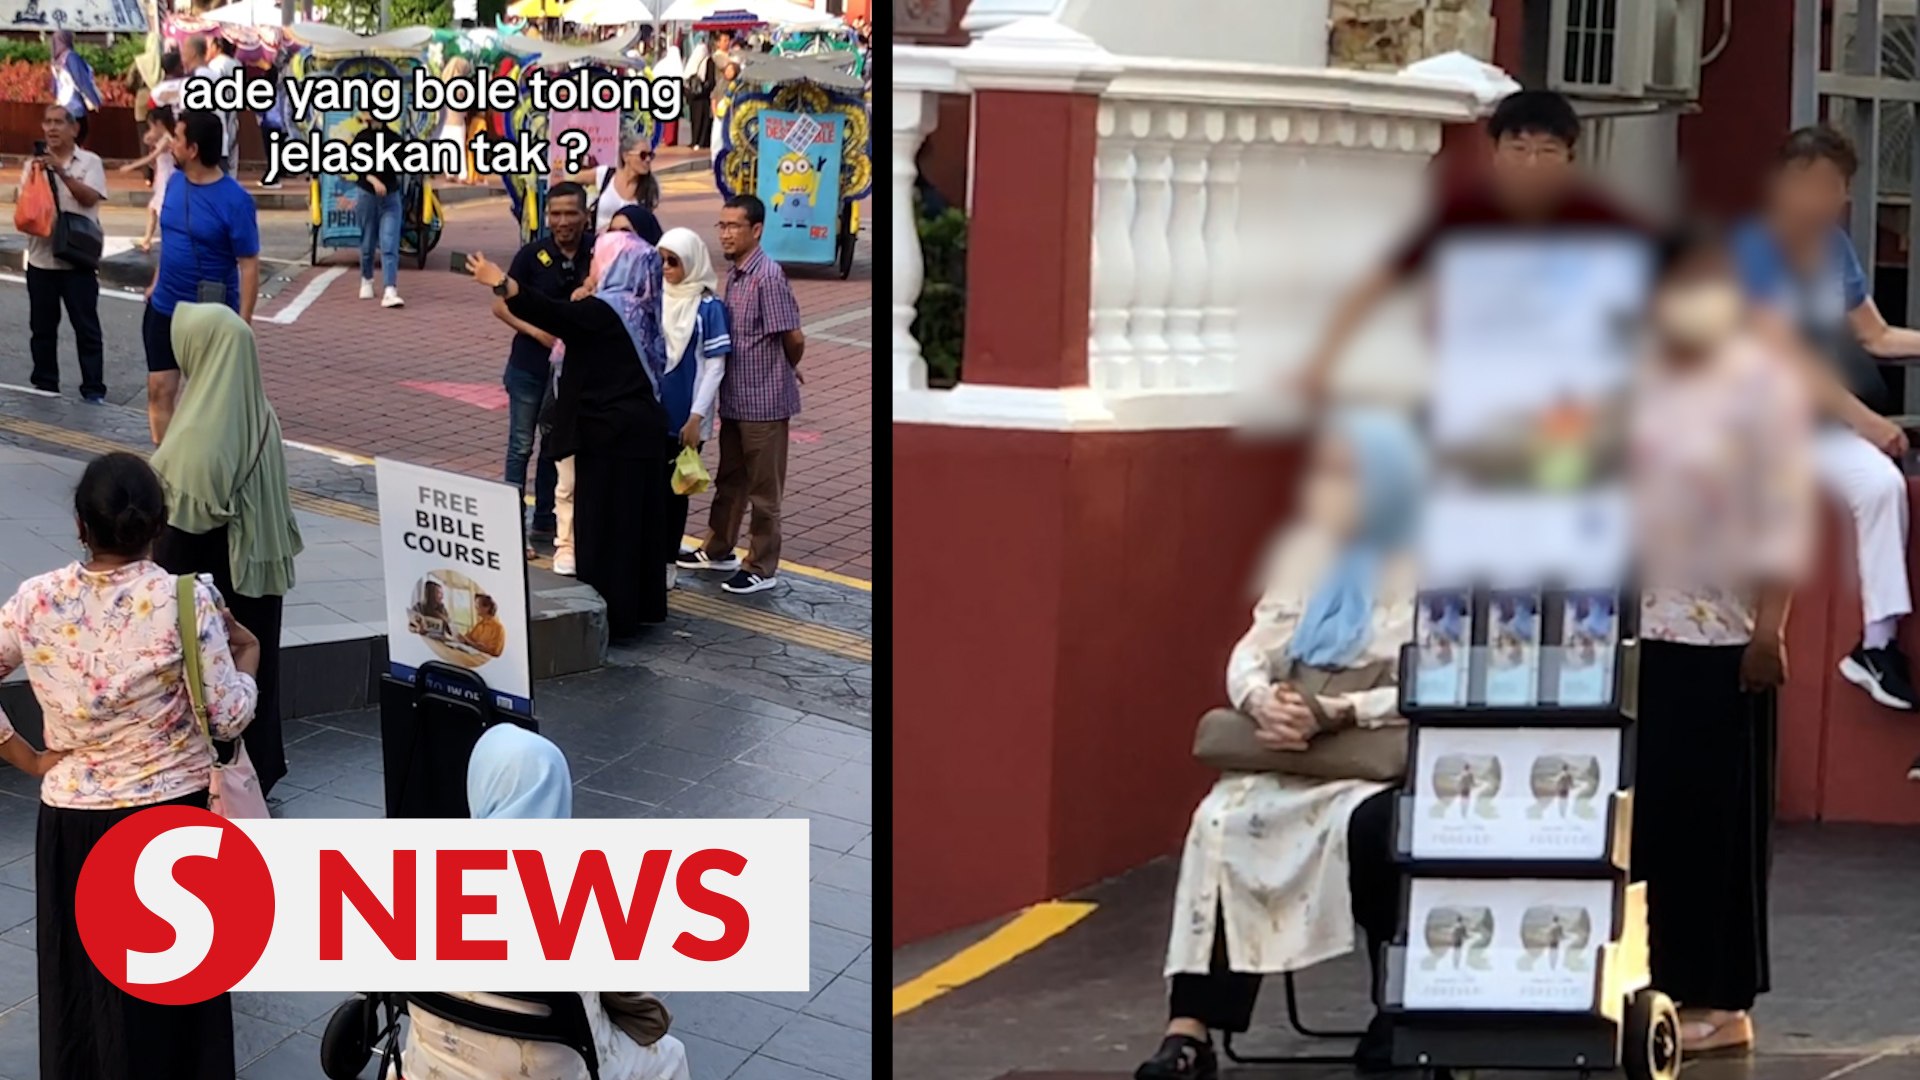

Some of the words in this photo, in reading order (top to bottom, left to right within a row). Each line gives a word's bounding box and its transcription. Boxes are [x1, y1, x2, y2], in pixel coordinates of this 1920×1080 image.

[418, 486, 478, 516] FREE
[416, 509, 484, 542] BIBLE
[403, 531, 501, 570] COURSE
